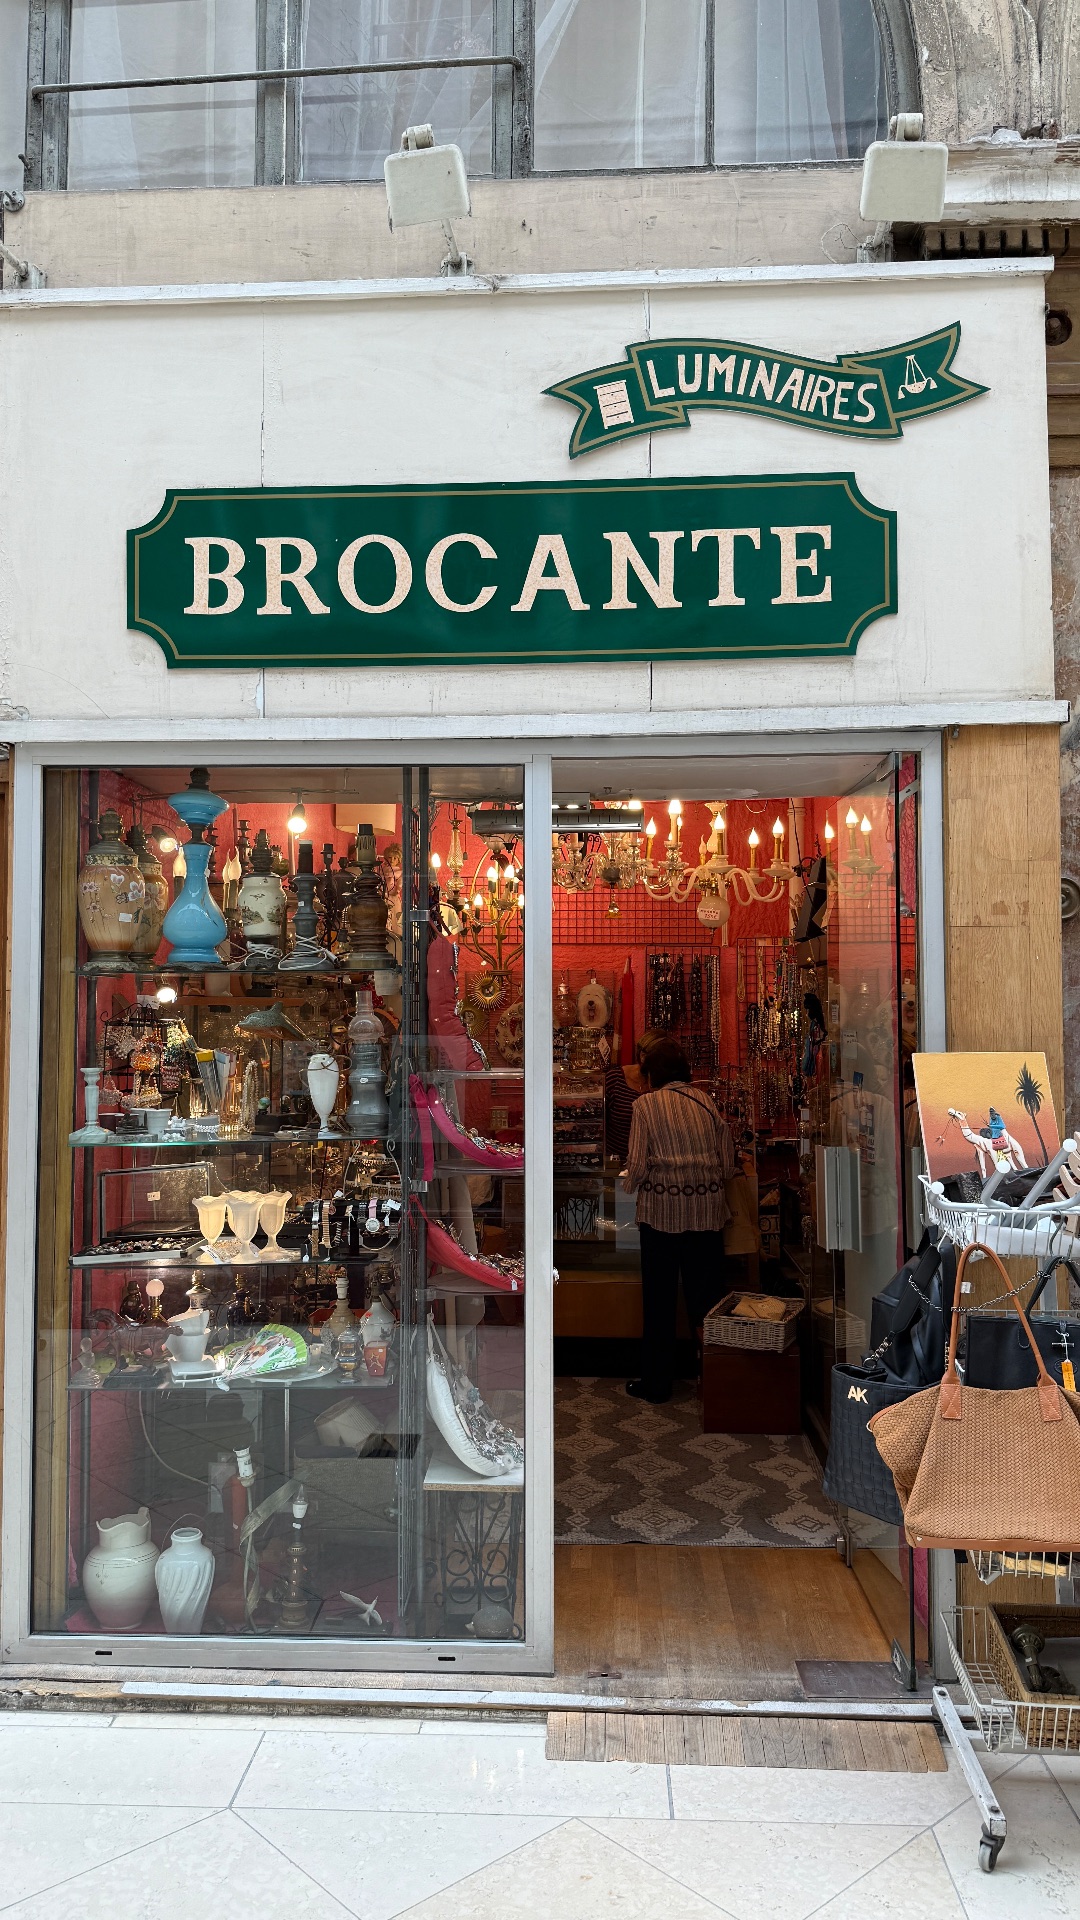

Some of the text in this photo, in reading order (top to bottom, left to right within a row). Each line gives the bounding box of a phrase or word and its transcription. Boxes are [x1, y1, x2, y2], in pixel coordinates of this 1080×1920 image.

[646, 353, 878, 423] LUMINAIRES
[183, 524, 833, 617] BROCANTE
[847, 1385, 869, 1405] AK
